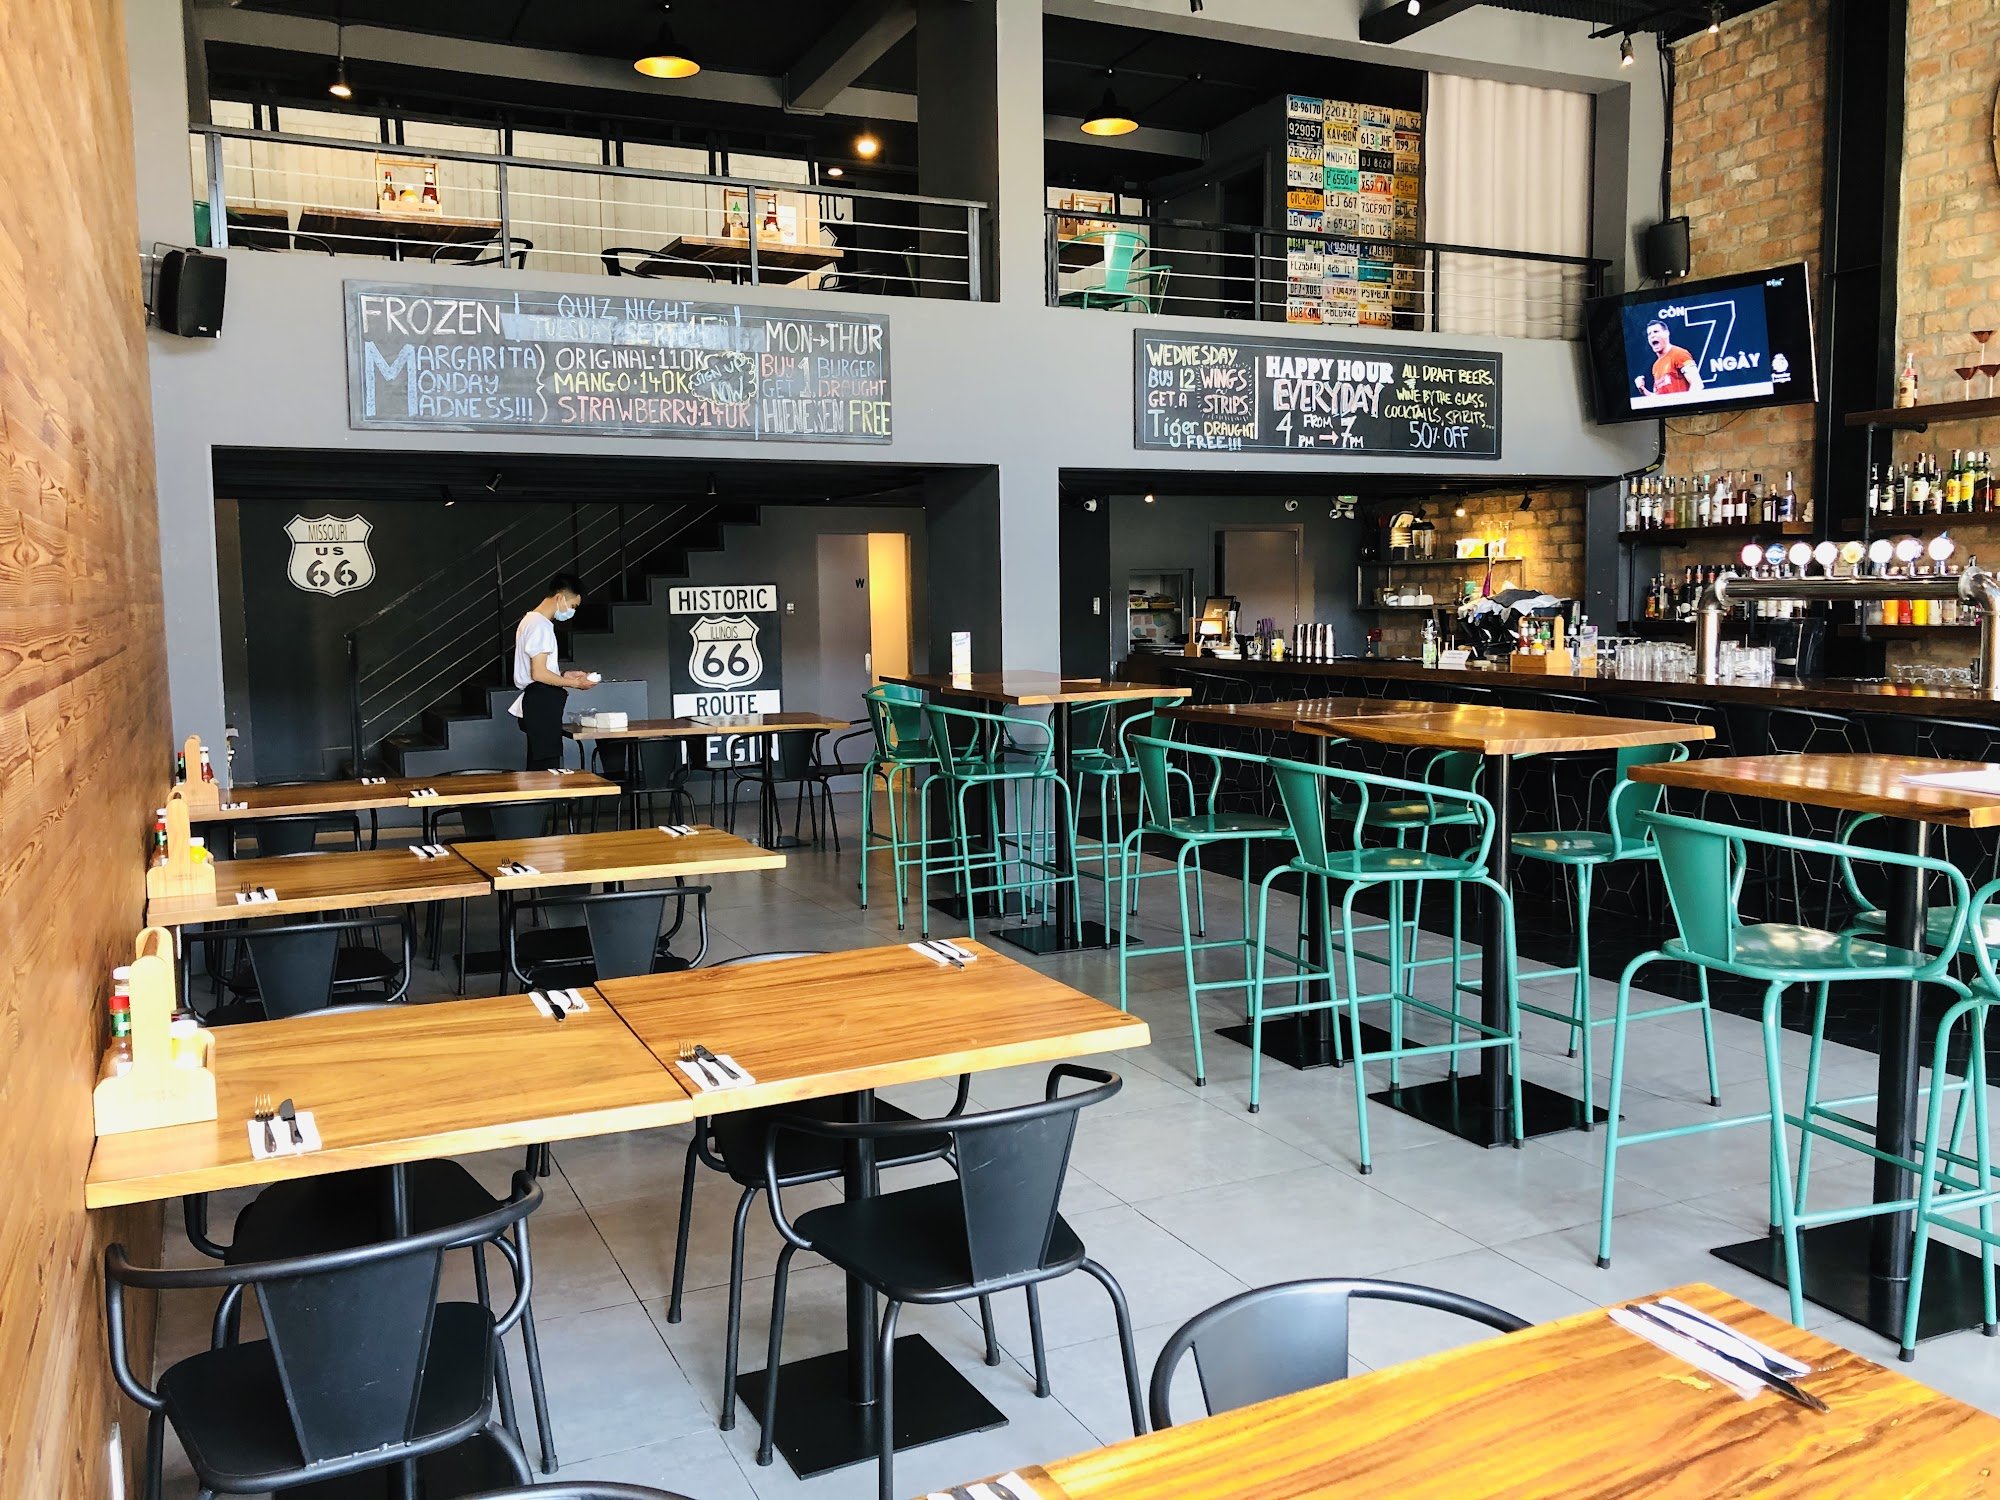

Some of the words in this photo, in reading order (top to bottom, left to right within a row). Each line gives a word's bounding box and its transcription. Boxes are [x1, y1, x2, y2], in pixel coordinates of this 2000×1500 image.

[1289, 122, 1321, 139] 929057
[1361, 132, 1375, 145] 613
[1326, 195, 1340, 207] LEJ
[1333, 218, 1357, 231] 69437
[360, 295, 501, 336] FROZEN
[558, 294, 618, 319] QUIZ
[624, 297, 694, 322] NIGHT
[1657, 304, 1686, 320] CÒN
[765, 320, 813, 354] MON
[825, 323, 883, 355] THUR
[1685, 300, 1736, 384] 7
[761, 353, 796, 378] BUY
[816, 356, 878, 379] BURGER
[1146, 343, 1238, 367] WEDNESDAY
[1709, 351, 1761, 374] NGÀY
[693, 364, 723, 387] SIGN
[1148, 369, 1174, 388] BUY
[1179, 368, 1196, 391] 12
[1200, 367, 1248, 391] WINGS
[1266, 356, 1334, 380] HAPPY
[1337, 359, 1395, 384] HOUR
[1402, 363, 1421, 380] ALL
[1422, 366, 1456, 385] DRAFT
[711, 376, 744, 403] NOW
[762, 378, 795, 398] GET
[818, 379, 887, 398] DRAUGHT
[1273, 378, 1385, 418] EVERYDAY
[1396, 388, 1421, 403] WINE
[1202, 394, 1249, 416] STRIPS
[849, 399, 892, 436] FREE
[1147, 409, 1200, 448] Tiger
[1203, 420, 1255, 438] DRAUGHT
[1275, 411, 1293, 447] 4
[1303, 413, 1333, 428] FROM
[1298, 434, 1315, 448] PM
[1409, 421, 1440, 449] 50%
[1443, 425, 1470, 449] OFF
[308, 524, 348, 541] MISSOURI
[306, 559, 358, 588] 66
[855, 578, 865, 589] W
[678, 588, 768, 611] HISTORIC
[710, 625, 739, 640] ILLINOIS
[702, 643, 750, 678] 66
[696, 694, 758, 717] ROUTE
